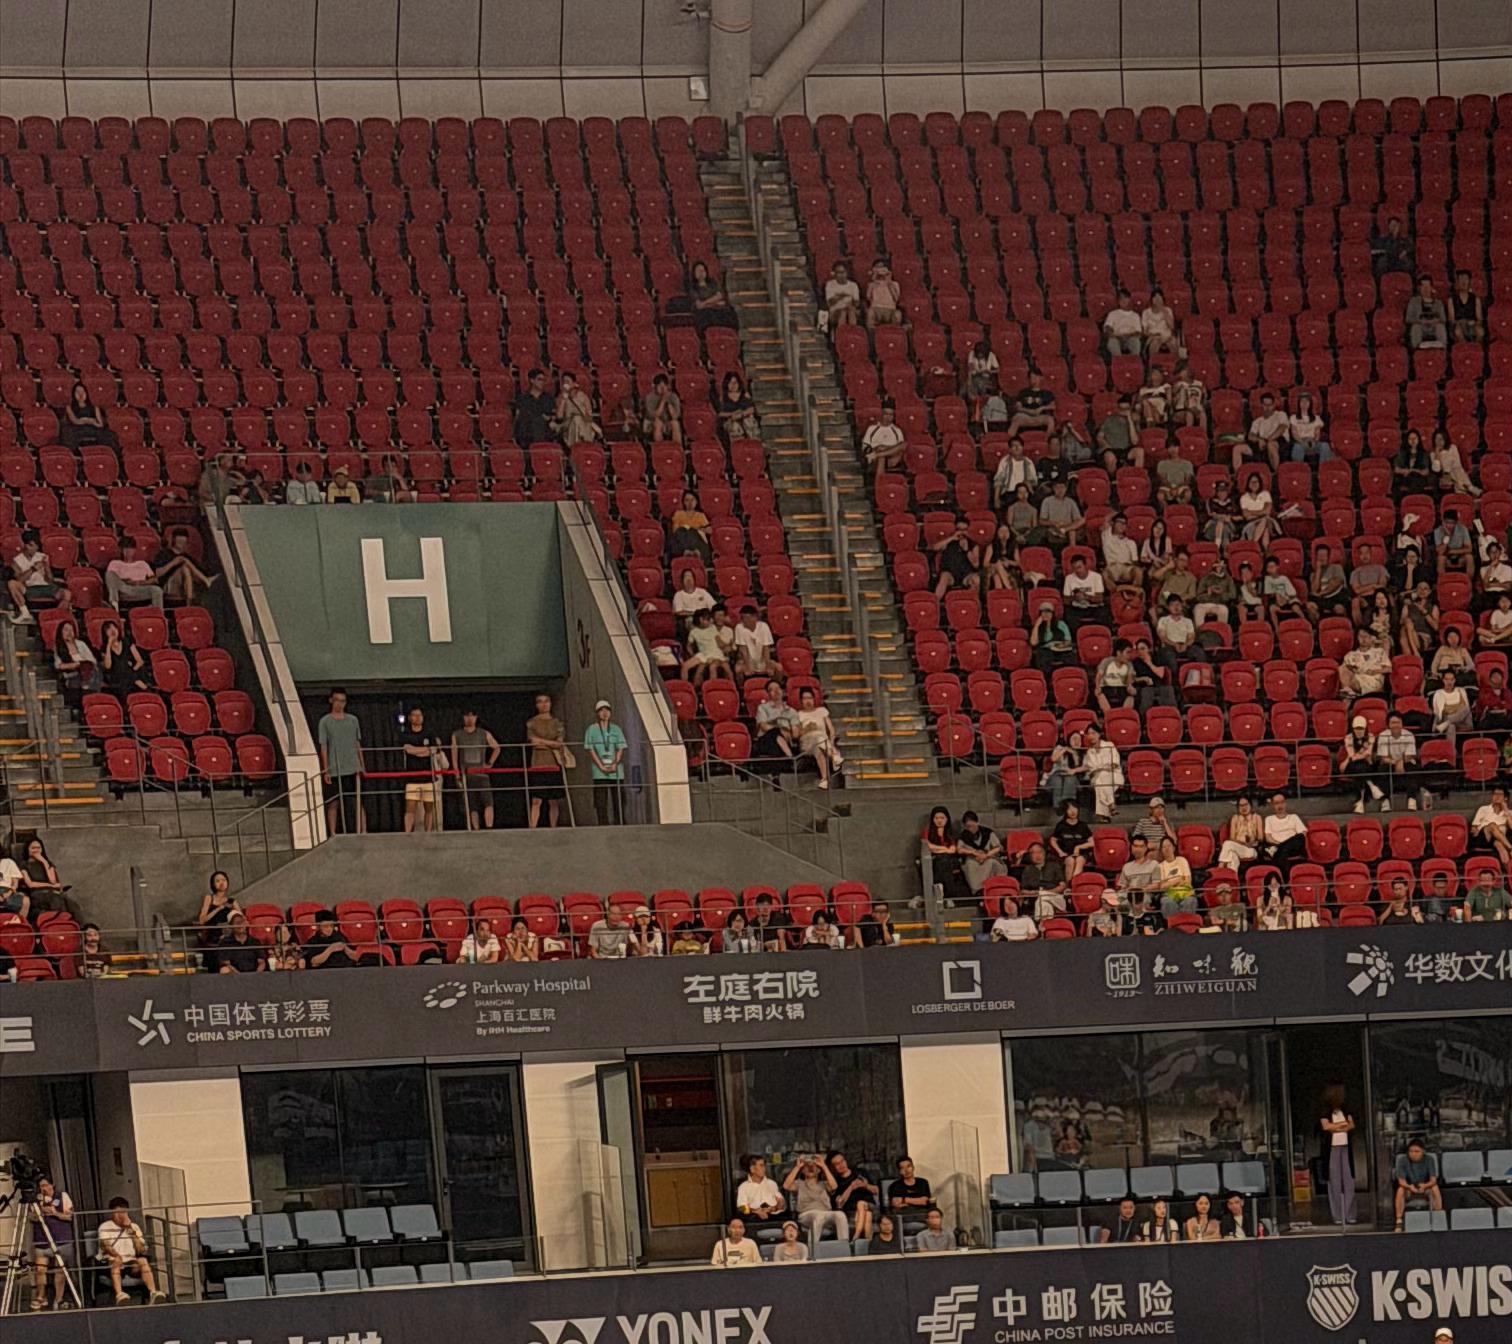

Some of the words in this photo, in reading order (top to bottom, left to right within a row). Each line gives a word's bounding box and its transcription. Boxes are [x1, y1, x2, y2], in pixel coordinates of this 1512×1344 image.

[361, 537, 453, 645] H
[473, 979, 531, 998] Parkway
[534, 976, 592, 996] Hospital
[683, 969, 822, 1004] 左庭右院
[1154, 980, 1257, 996] ZHIWEIGUAN
[184, 999, 332, 1028] 中国体育彩票
[703, 1003, 805, 1025] 鲜牛肉火锅
[911, 1003, 971, 1015] LOSBERGER
[187, 1031, 225, 1044] CHINA
[227, 1028, 275, 1042] SPORTS
[277, 1025, 332, 1041] LOTTERY
[992, 1279, 1175, 1326] 中邮保险
[994, 1330, 1040, 1344] CHINA
[1043, 1326, 1086, 1343] POST
[1088, 1320, 1175, 1340] INSURANCE
